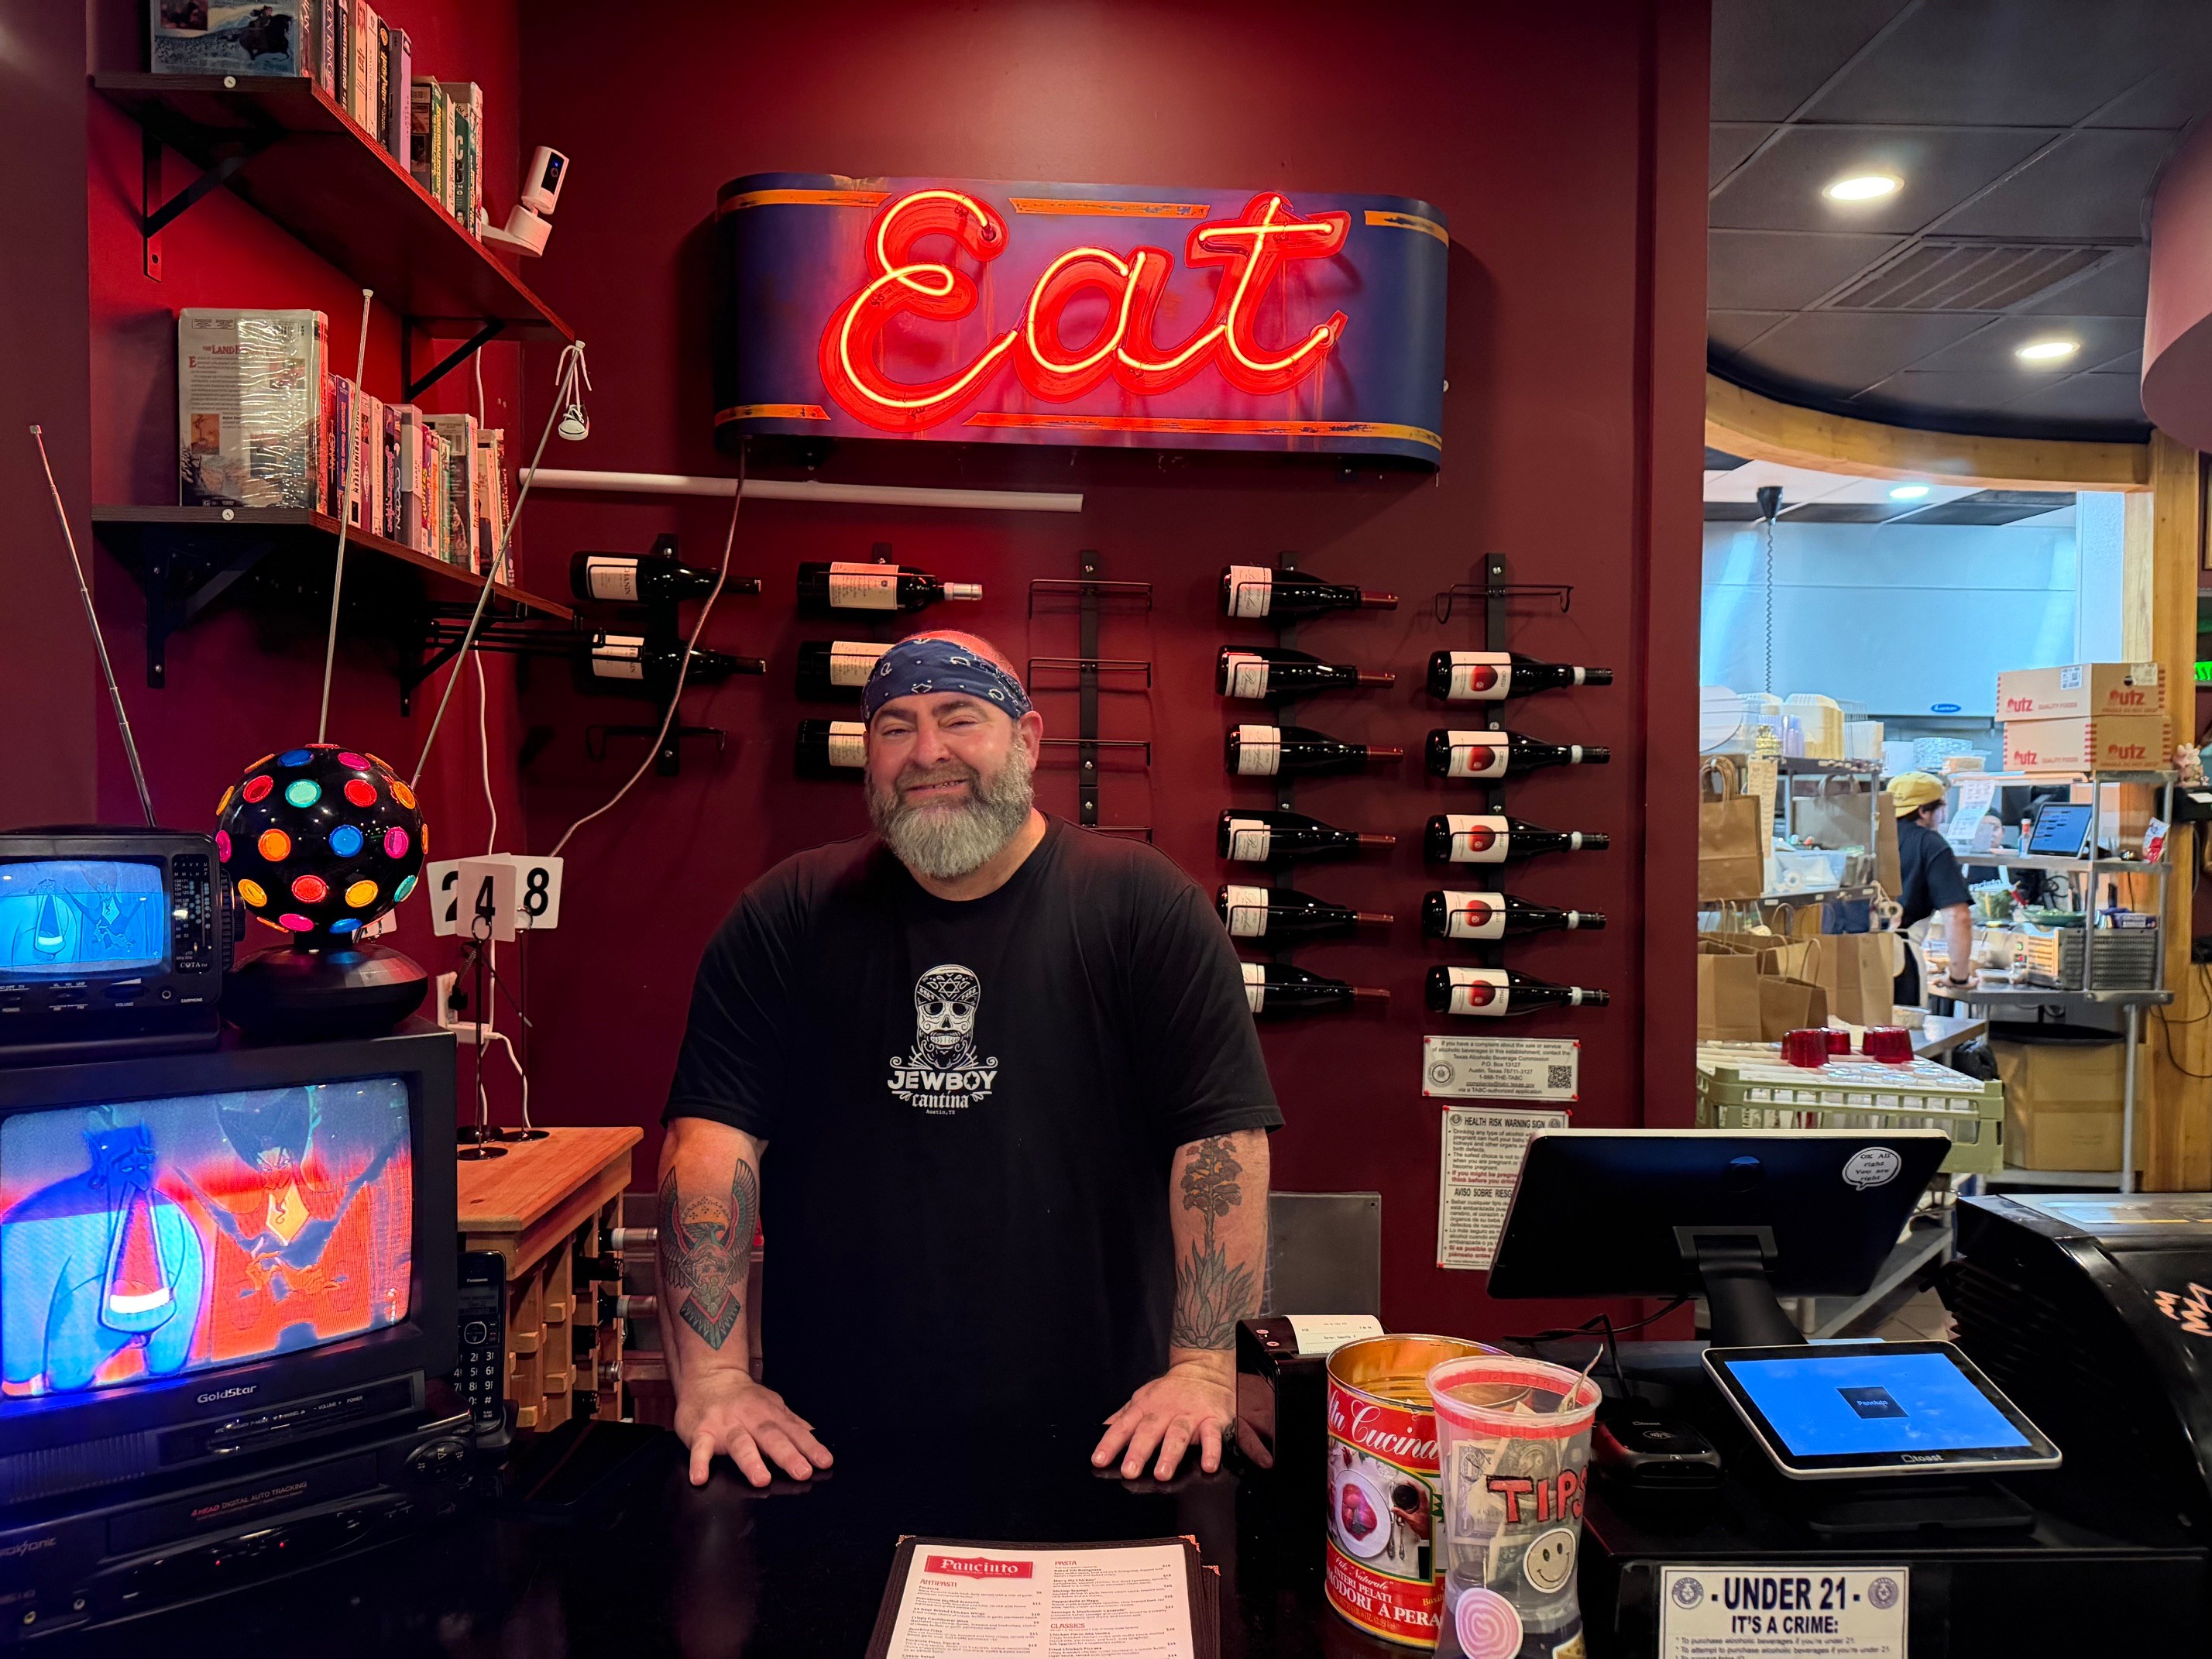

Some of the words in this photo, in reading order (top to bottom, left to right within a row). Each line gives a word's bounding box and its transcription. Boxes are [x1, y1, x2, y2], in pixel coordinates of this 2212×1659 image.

[819, 188, 1352, 433] Eat
[211, 345, 235, 355] LAND
[475, 876, 495, 926] 4
[524, 867, 549, 916] 8
[888, 1070, 998, 1091] JEWBOY
[1465, 1117, 1486, 1126] HEALTH
[1488, 1118, 1502, 1127] RISK
[1505, 1118, 1530, 1128] WARNING
[1532, 1120, 1545, 1128] SIGN
[197, 1385, 257, 1403] GoldStar
[318, 1402, 337, 1410] VOLUME
[1328, 1389, 1345, 1431] lta
[1351, 1400, 1438, 1460] Cucina
[222, 1496, 249, 1509] DIGITAL
[251, 1492, 270, 1501] AUTO
[272, 1482, 307, 1496] TRACKING
[1486, 1465, 1588, 1524] TIPS
[919, 1578, 957, 1587] ANTIPASTI
[1327, 1568, 1372, 1612] MODORI
[1378, 1603, 1391, 1619] A
[1393, 1606, 1441, 1627] PERA
[1334, 1565, 1357, 1589] INTERI
[1358, 1583, 1393, 1604] PELATI
[1724, 1577, 1811, 1610] UNDER
[1819, 1577, 1846, 1610] 21
[1732, 1616, 1761, 1633] IT'S
[1767, 1616, 1778, 1633] A
[1784, 1616, 1838, 1633] CRIME:
